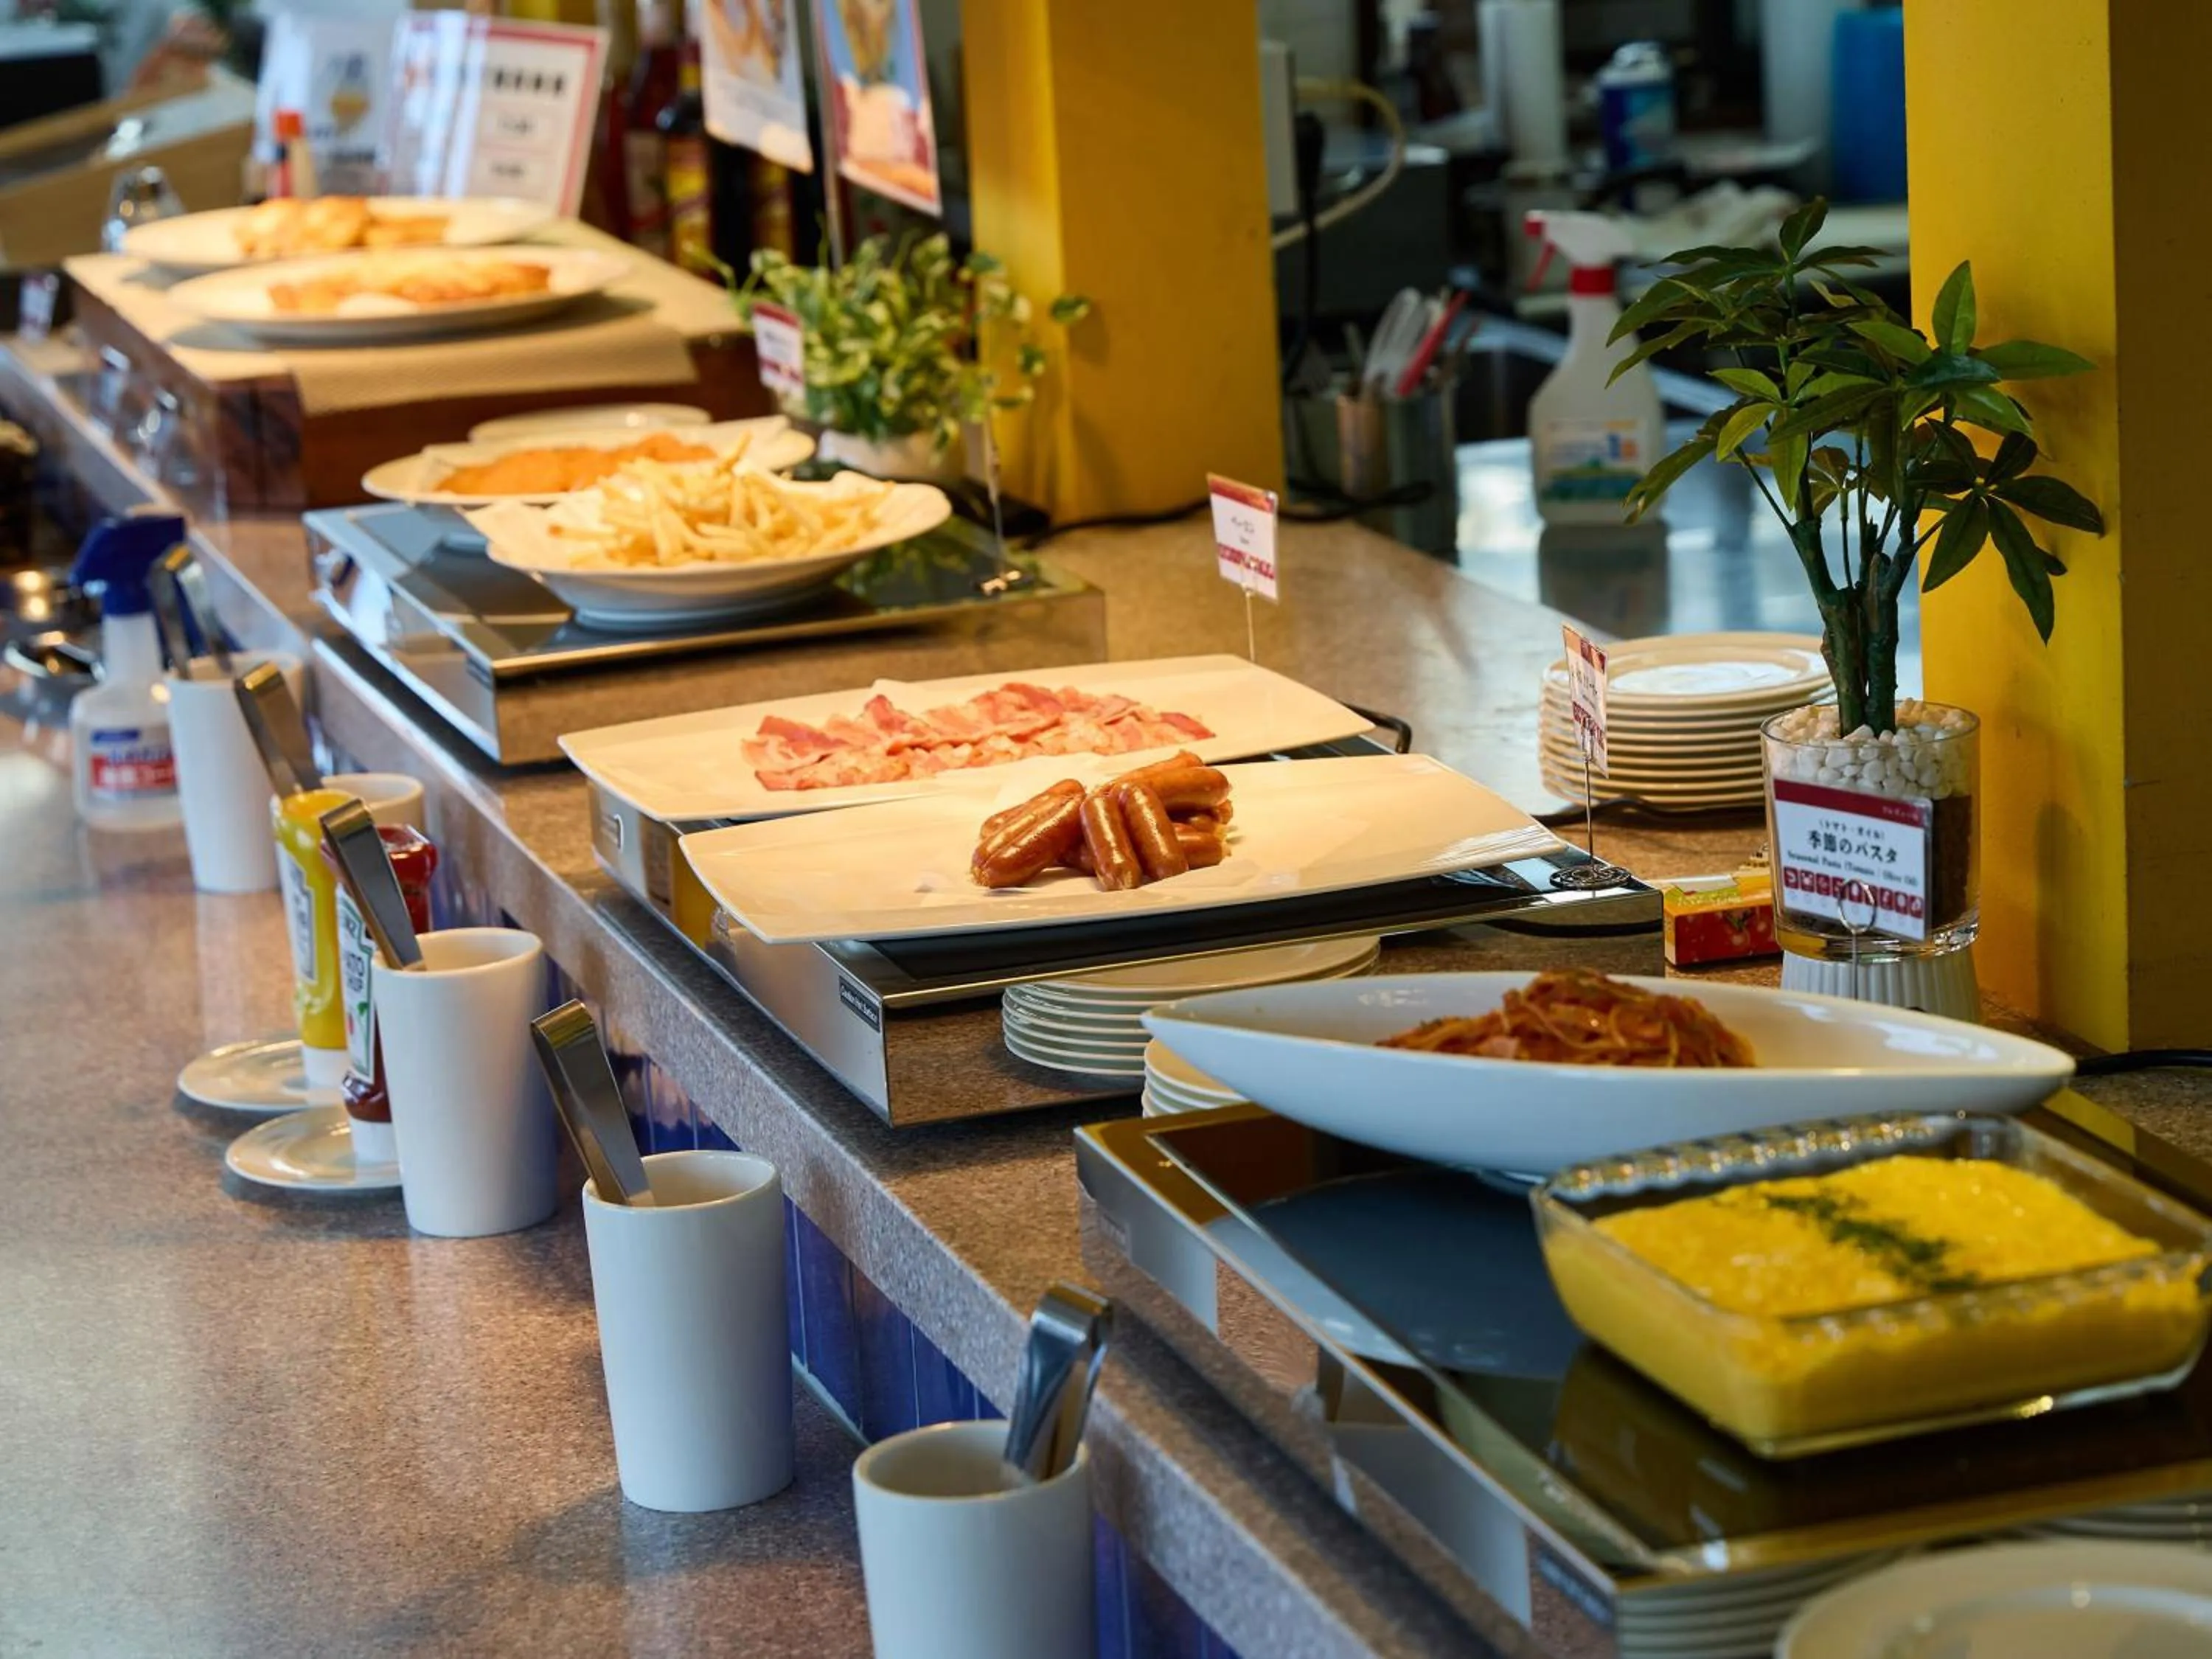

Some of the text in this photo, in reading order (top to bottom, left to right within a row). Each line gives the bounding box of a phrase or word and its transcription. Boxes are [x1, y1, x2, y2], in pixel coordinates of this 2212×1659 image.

[1808, 830, 1897, 863] 季節のパスタ
